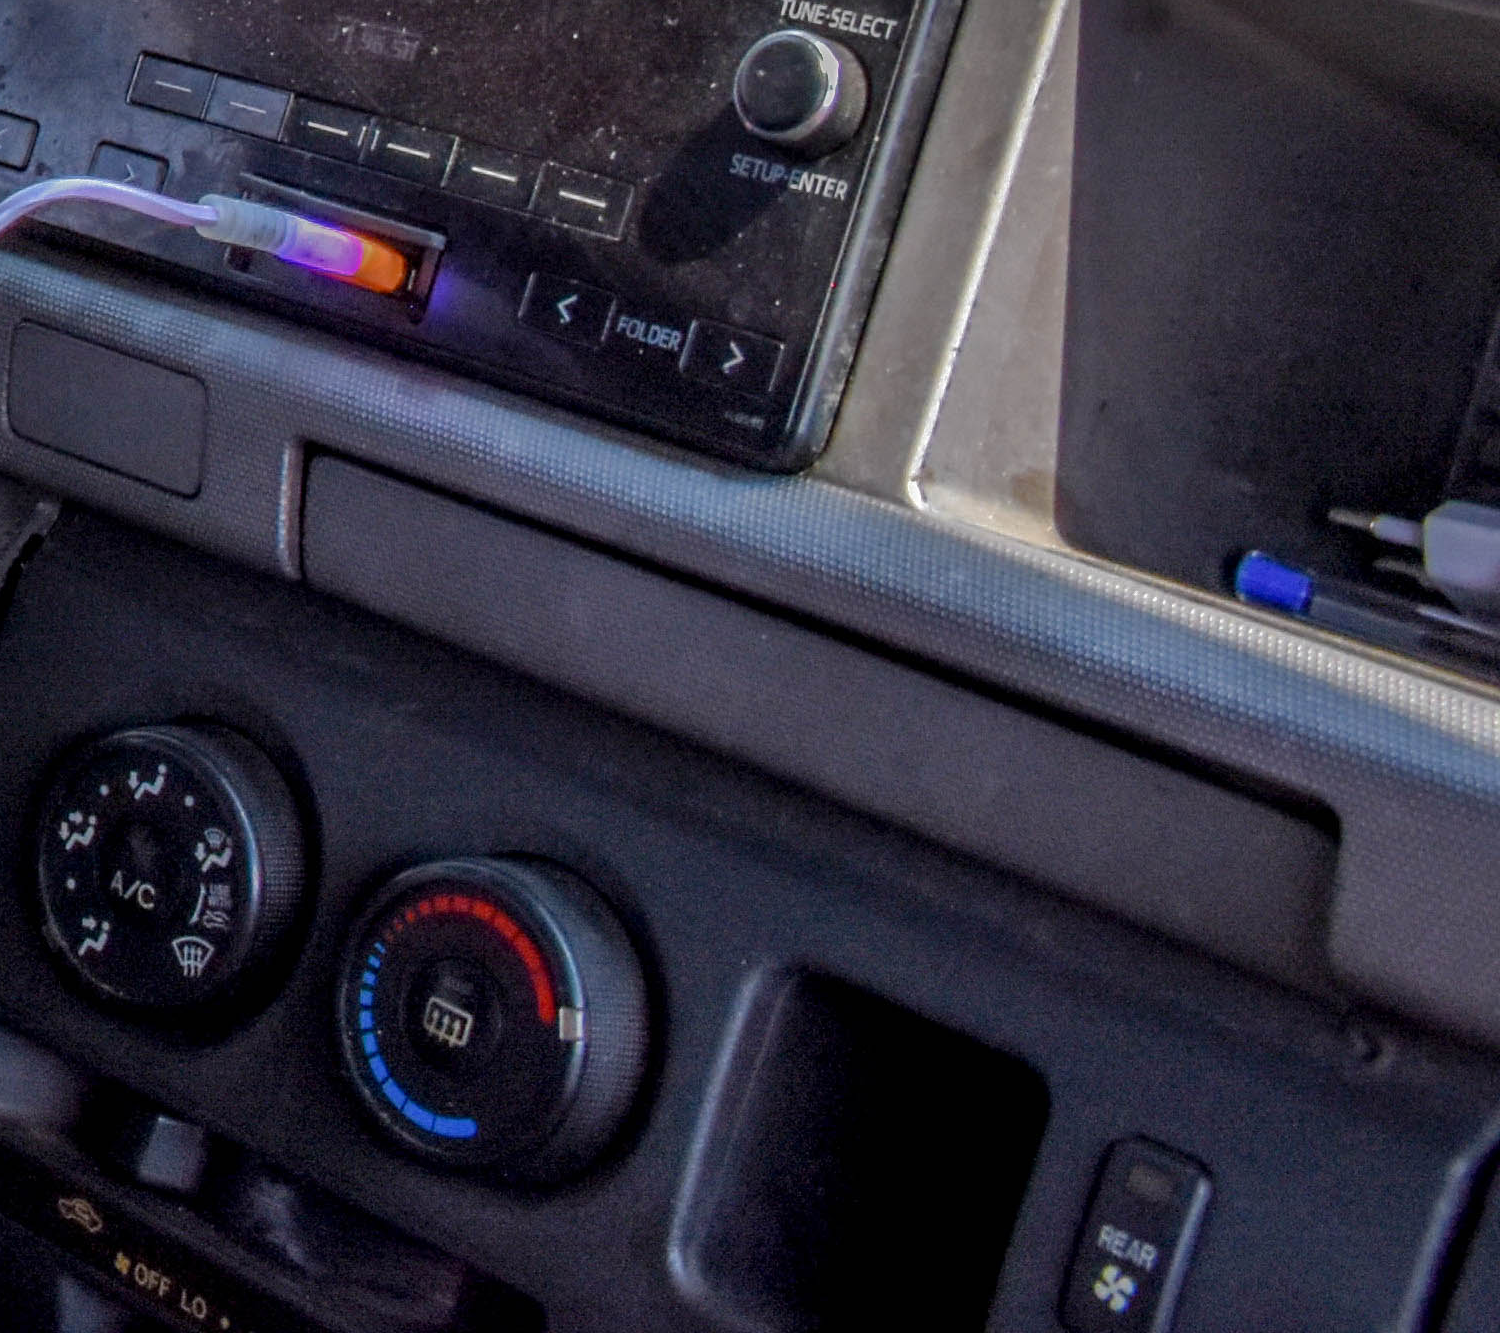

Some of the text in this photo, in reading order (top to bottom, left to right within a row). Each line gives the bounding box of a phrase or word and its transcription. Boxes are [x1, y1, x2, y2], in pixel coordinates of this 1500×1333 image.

[616, 316, 681, 351] FOLDER
[110, 870, 155, 909] A/C
[1098, 1224, 1160, 1271] REAR
[134, 1262, 207, 1319] OFF LO
